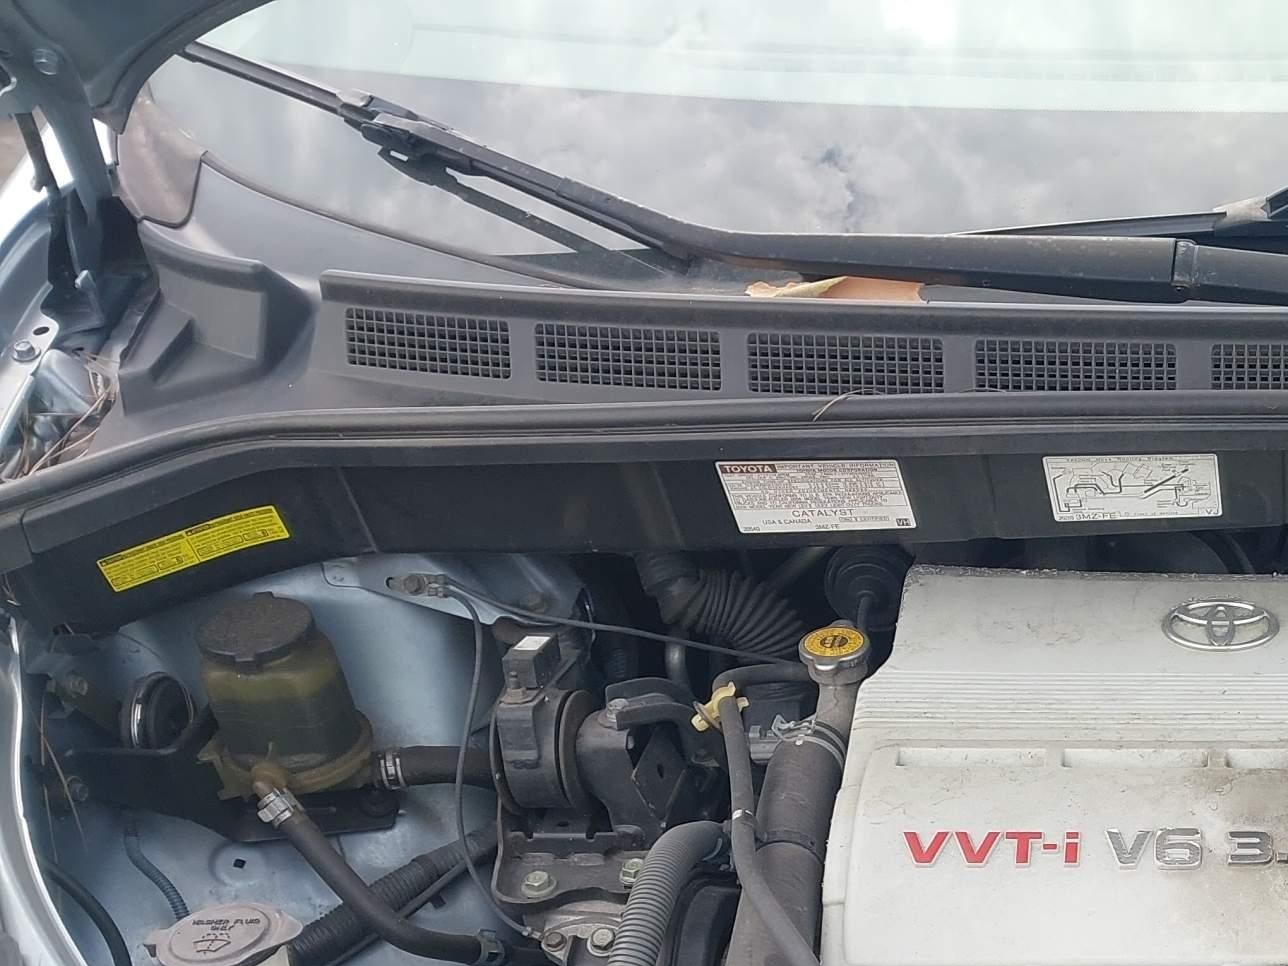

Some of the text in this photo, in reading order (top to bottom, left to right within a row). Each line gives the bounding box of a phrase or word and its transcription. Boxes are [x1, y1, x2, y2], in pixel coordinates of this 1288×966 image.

[723, 465, 773, 473] TOYOTA
[791, 508, 855, 518] CATALYST
[903, 830, 1082, 868] VVT-i
[1106, 827, 1202, 870] V6
